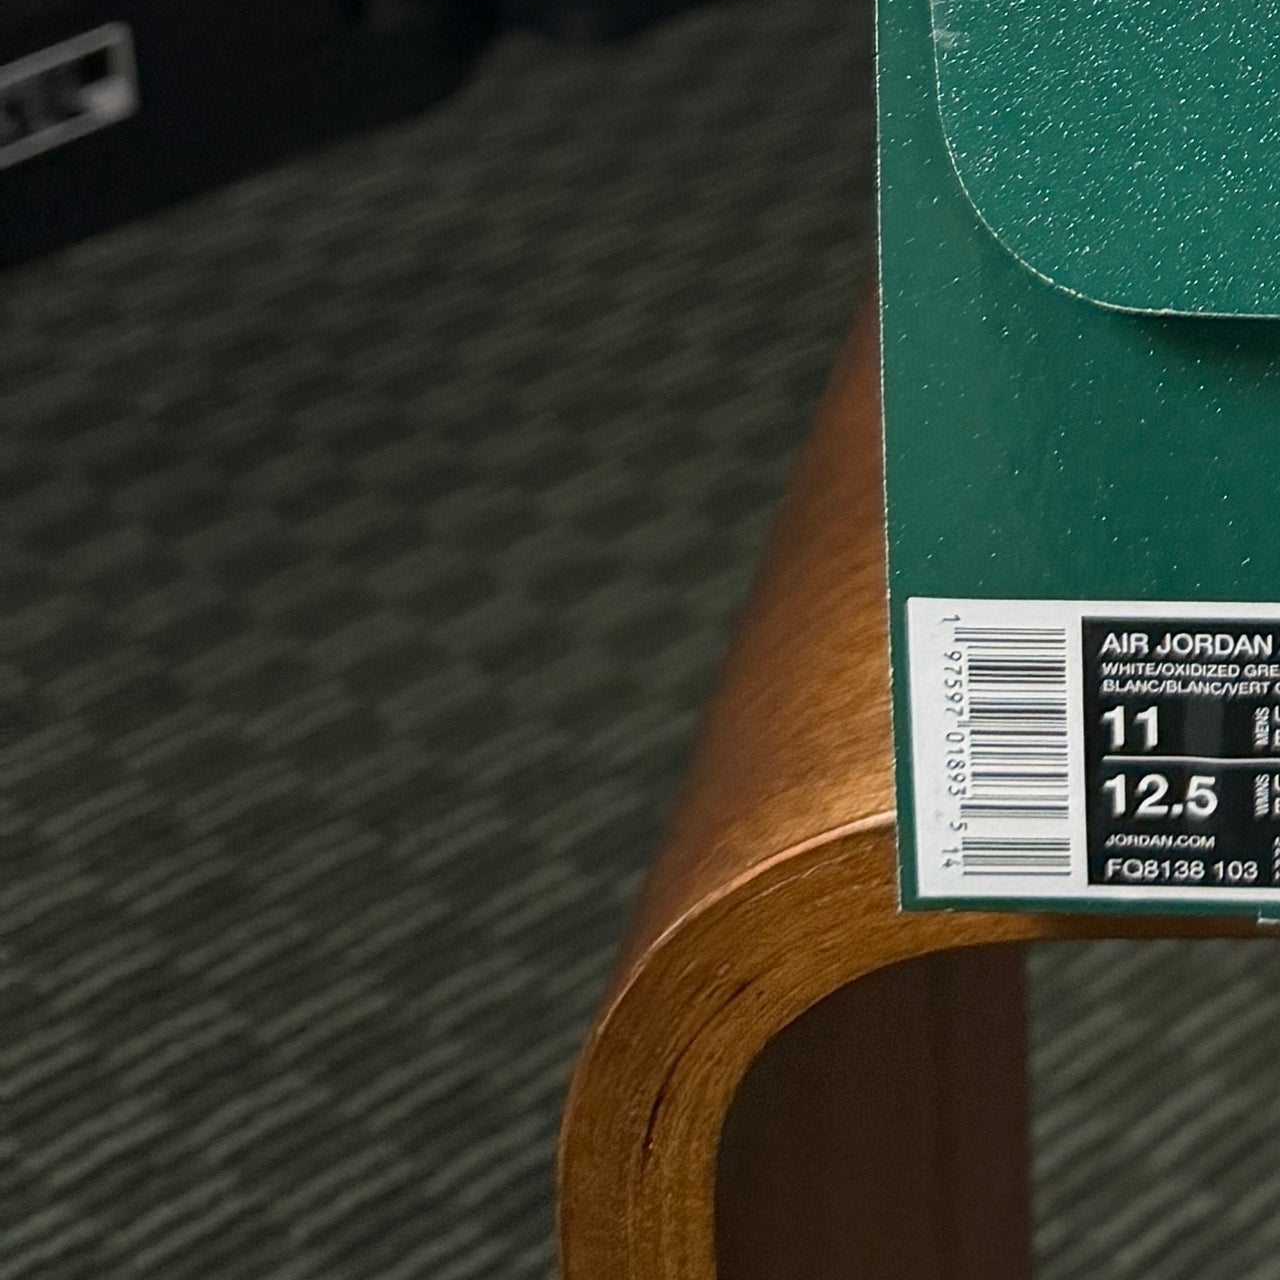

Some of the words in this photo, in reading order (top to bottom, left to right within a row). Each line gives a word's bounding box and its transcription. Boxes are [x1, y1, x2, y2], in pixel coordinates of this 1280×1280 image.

[1100, 633, 1149, 655] AIR
[1155, 633, 1273, 656] JORDAN
[1102, 662, 1240, 678] WHITE/OXIDIZED
[1102, 679, 1269, 695] BLANC/BLANC/VERT
[1102, 705, 1158, 747] 11
[1103, 773, 1218, 816] 12.5
[1106, 834, 1215, 848] JORDAN.COM
[1105, 859, 1205, 879] FQ8138
[1214, 860, 1258, 880] 103
